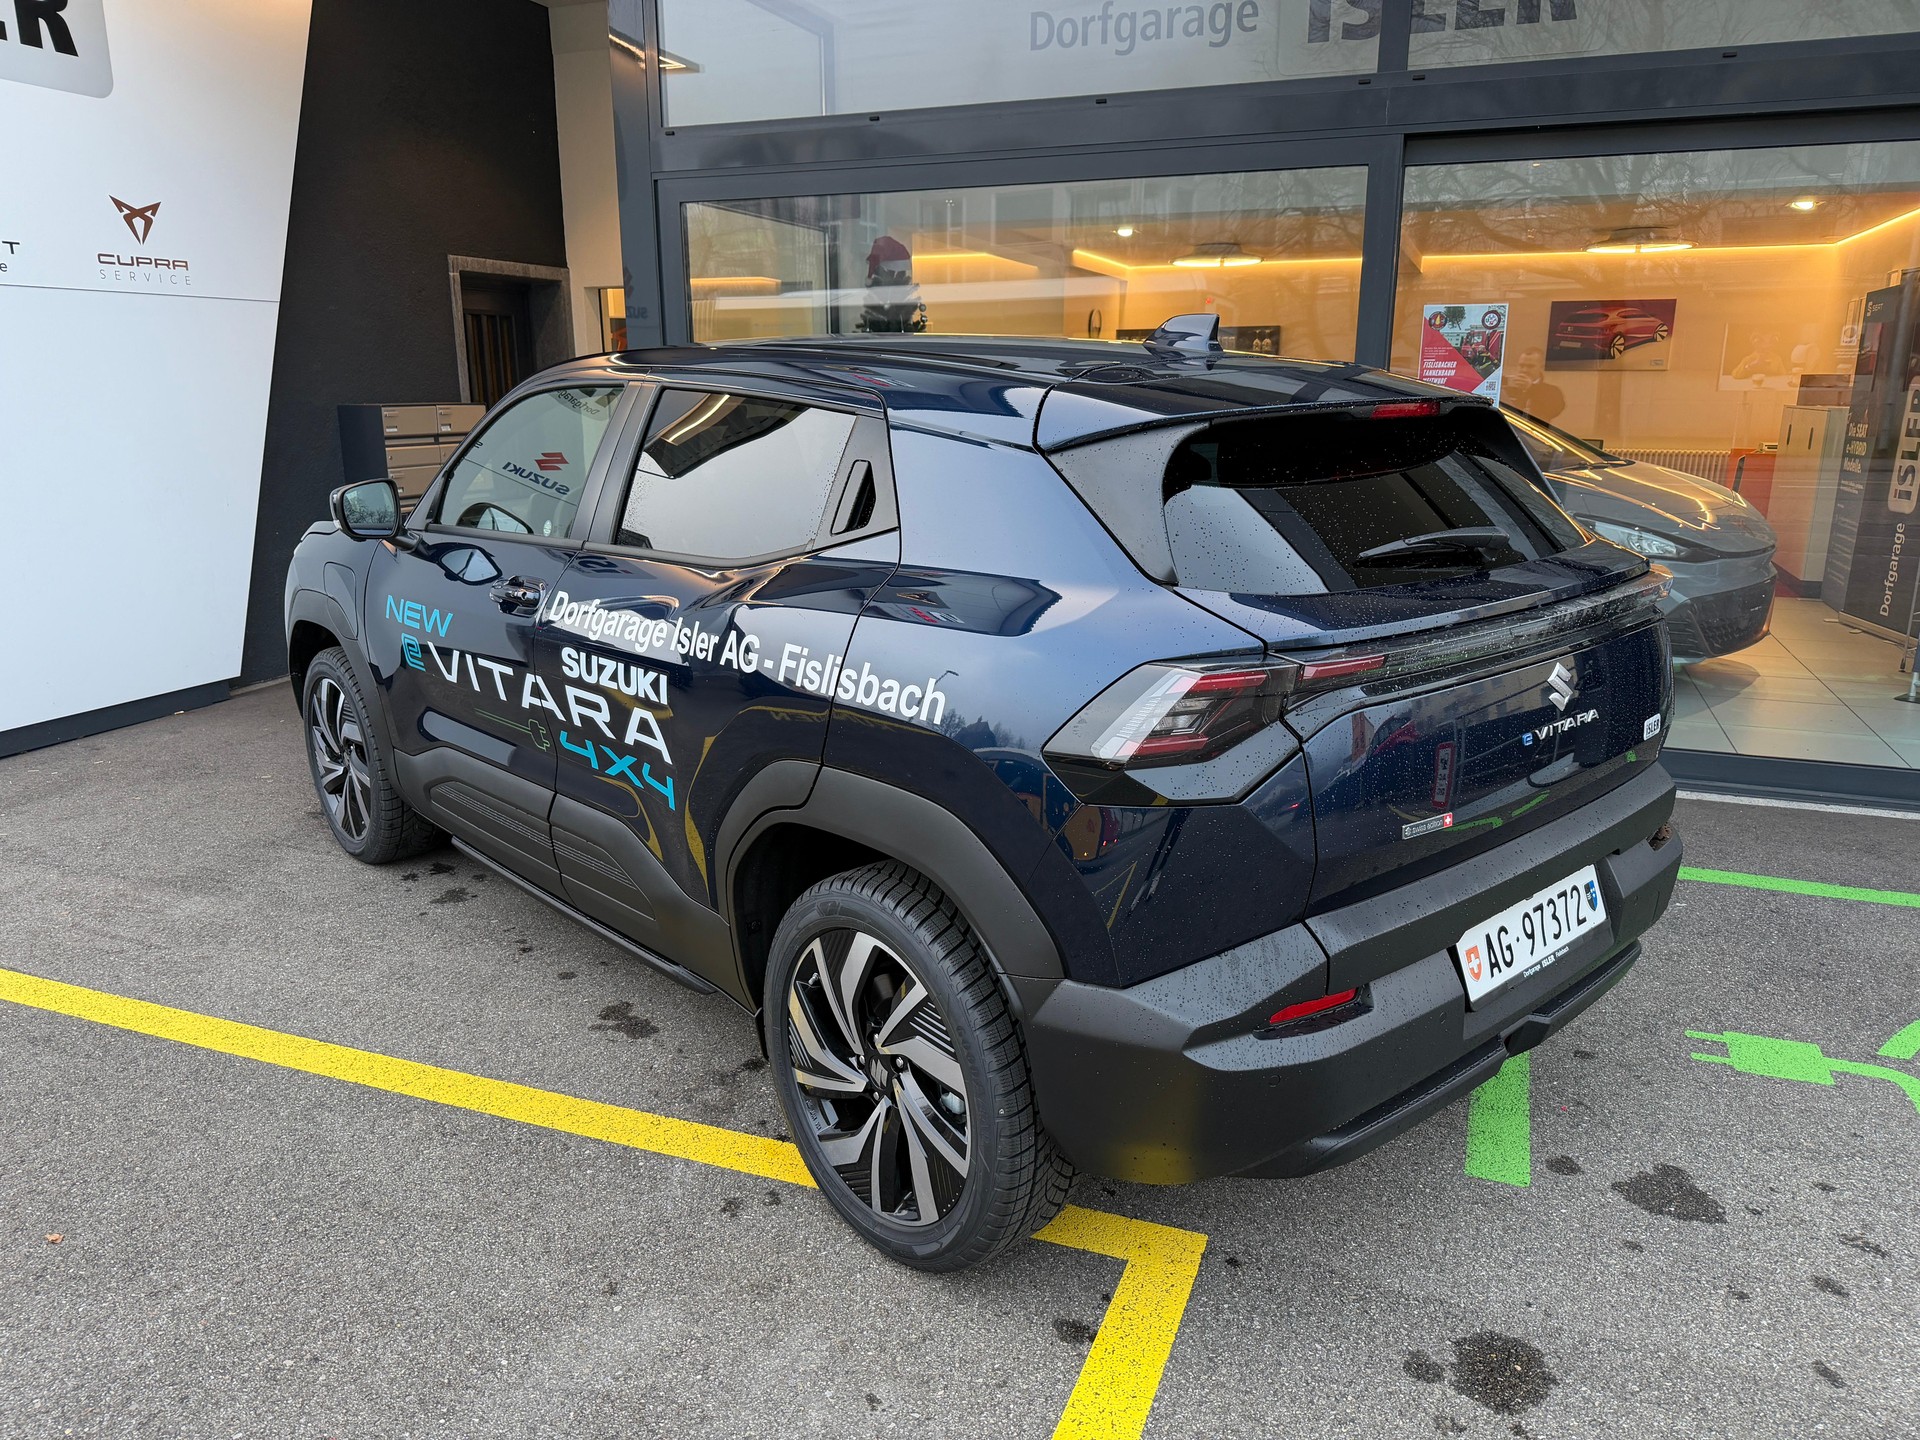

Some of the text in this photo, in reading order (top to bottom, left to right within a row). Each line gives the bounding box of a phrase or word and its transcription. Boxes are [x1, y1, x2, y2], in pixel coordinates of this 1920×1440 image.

[1030, 0, 1259, 56] Dorfgarage
[97, 253, 189, 271] CUPRA
[99, 268, 191, 286] SERVICE
[1879, 522, 1905, 617] Dorfgarage
[385, 594, 453, 638] NEW
[549, 590, 668, 653] Dorfgarage
[670, 615, 720, 663] Isler
[720, 629, 761, 674] AG
[778, 642, 946, 726] Fislisbach
[561, 646, 669, 705] SUZUKI
